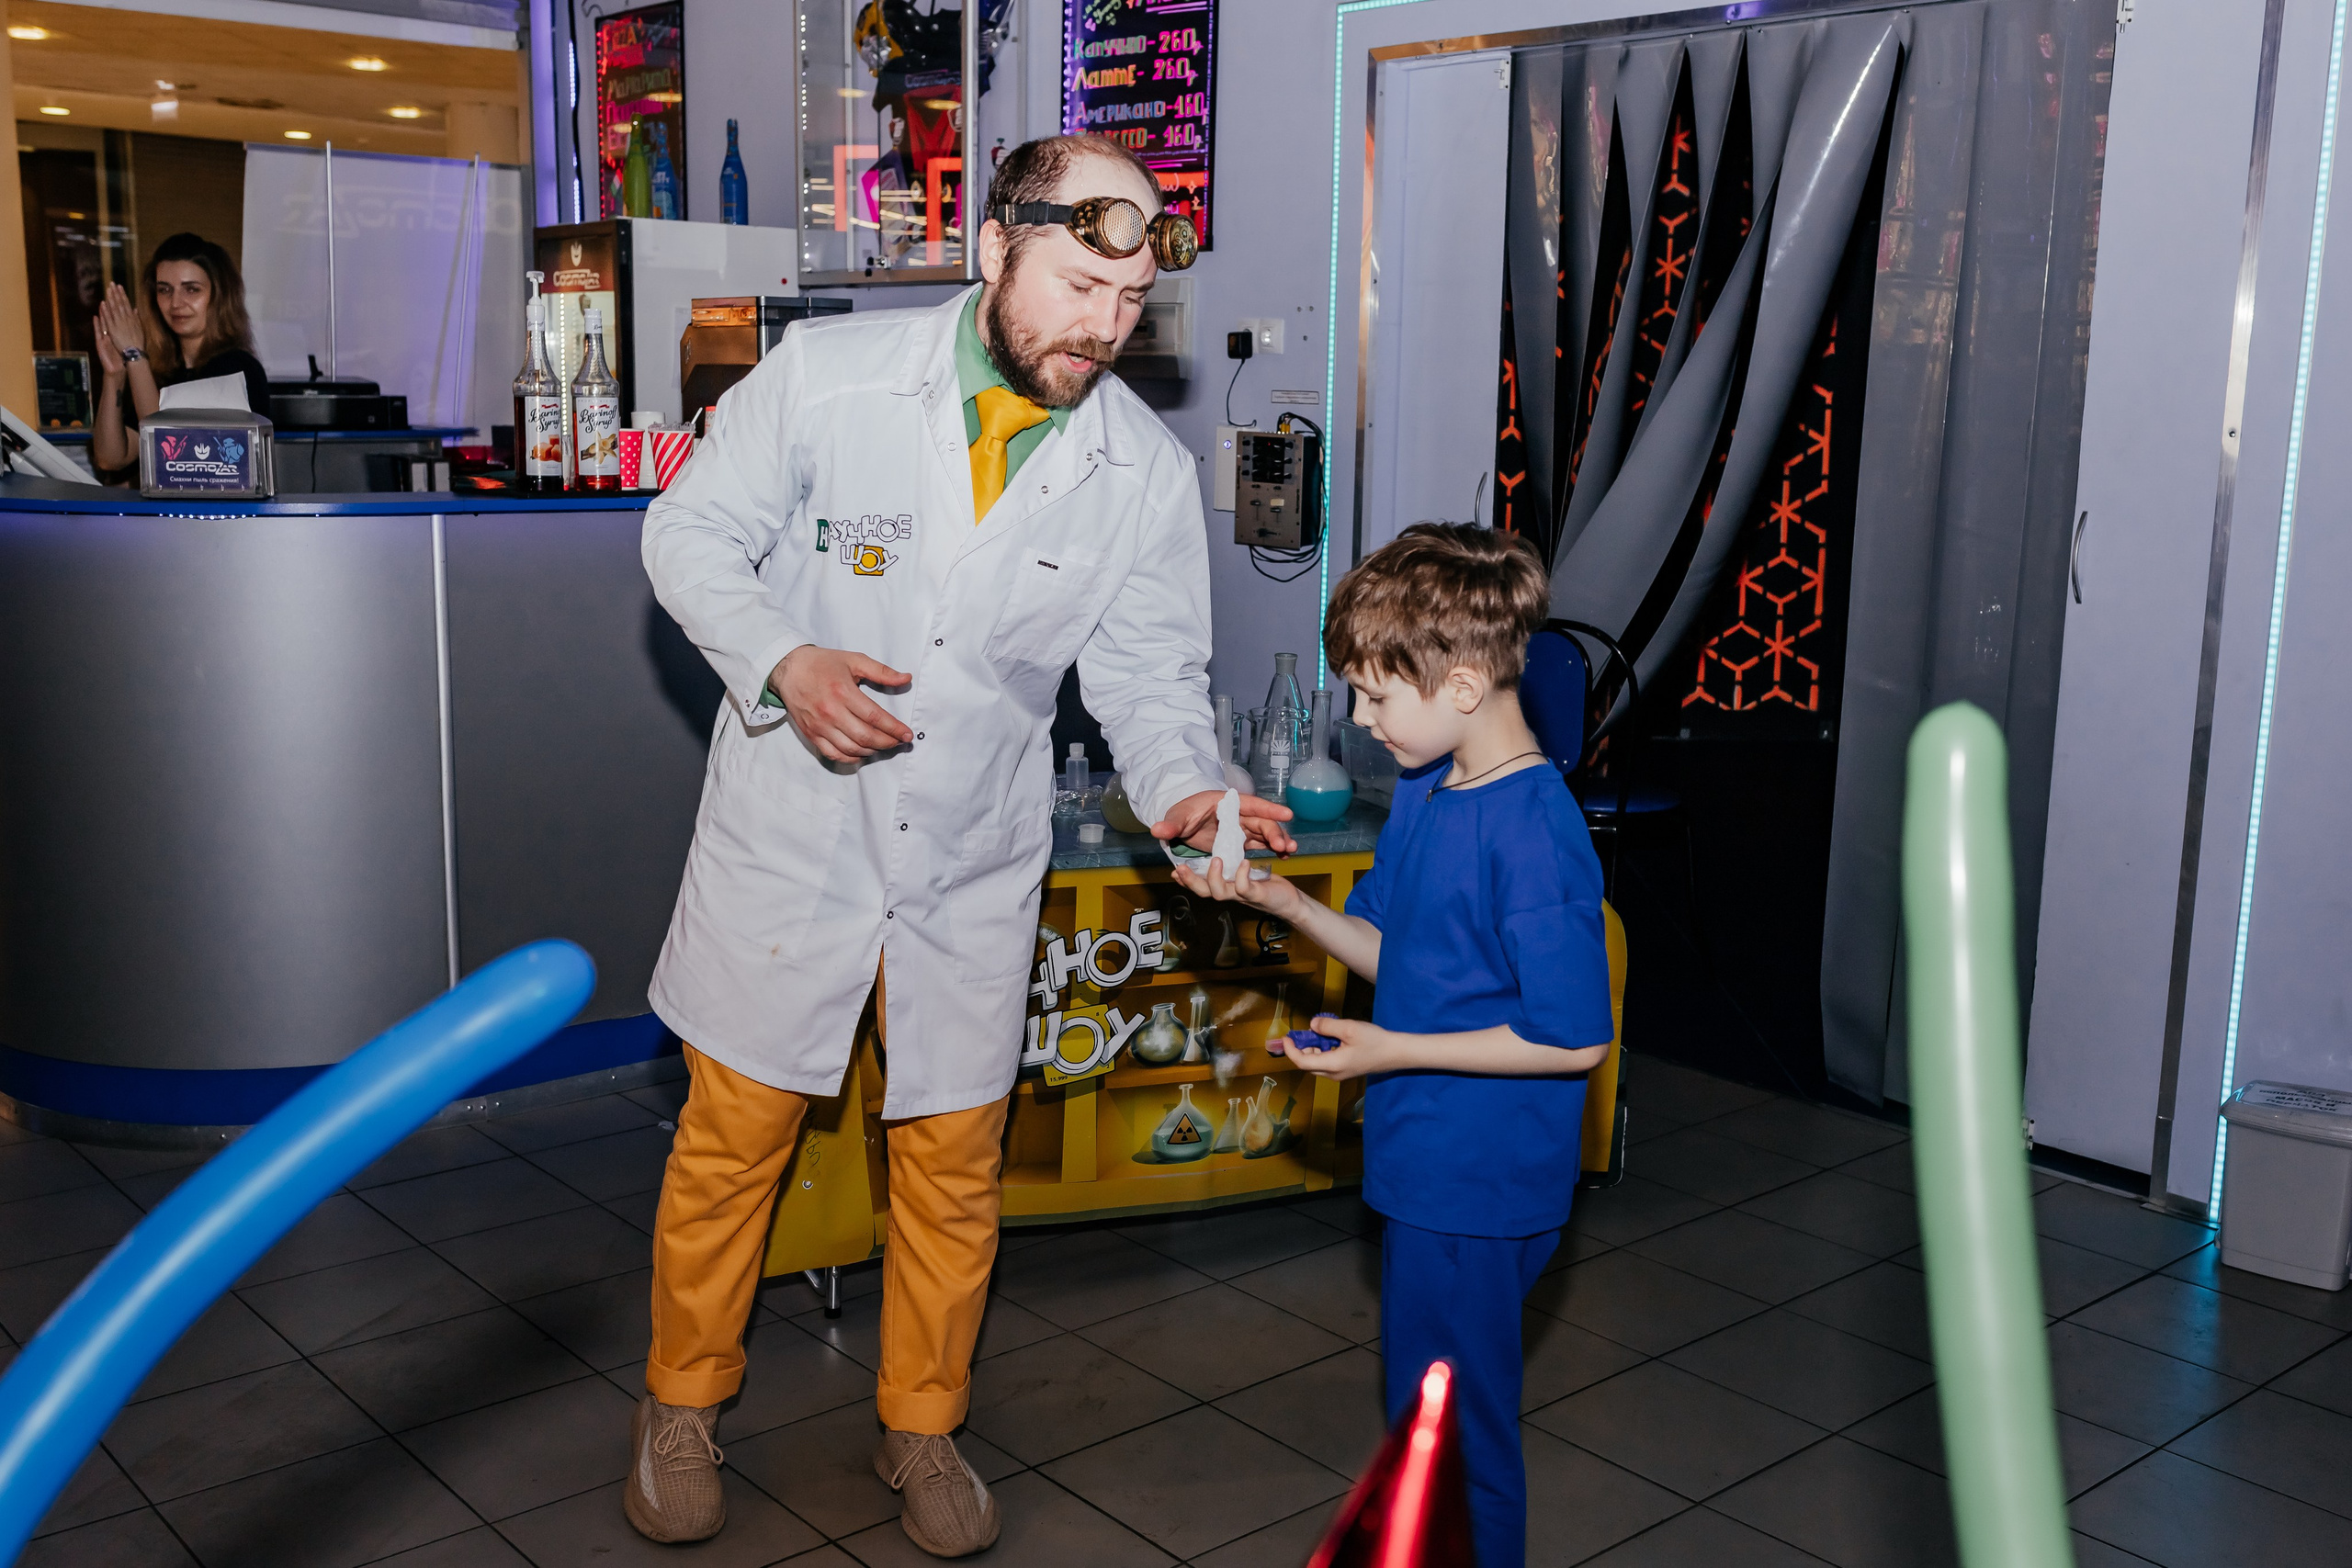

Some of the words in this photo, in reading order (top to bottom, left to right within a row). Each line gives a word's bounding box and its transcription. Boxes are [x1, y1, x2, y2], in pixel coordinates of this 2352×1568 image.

[585, 418, 613, 433] Syrup
[816, 514, 911, 552] НАУЧНОЕ
[841, 544, 899, 574] ШОУ
